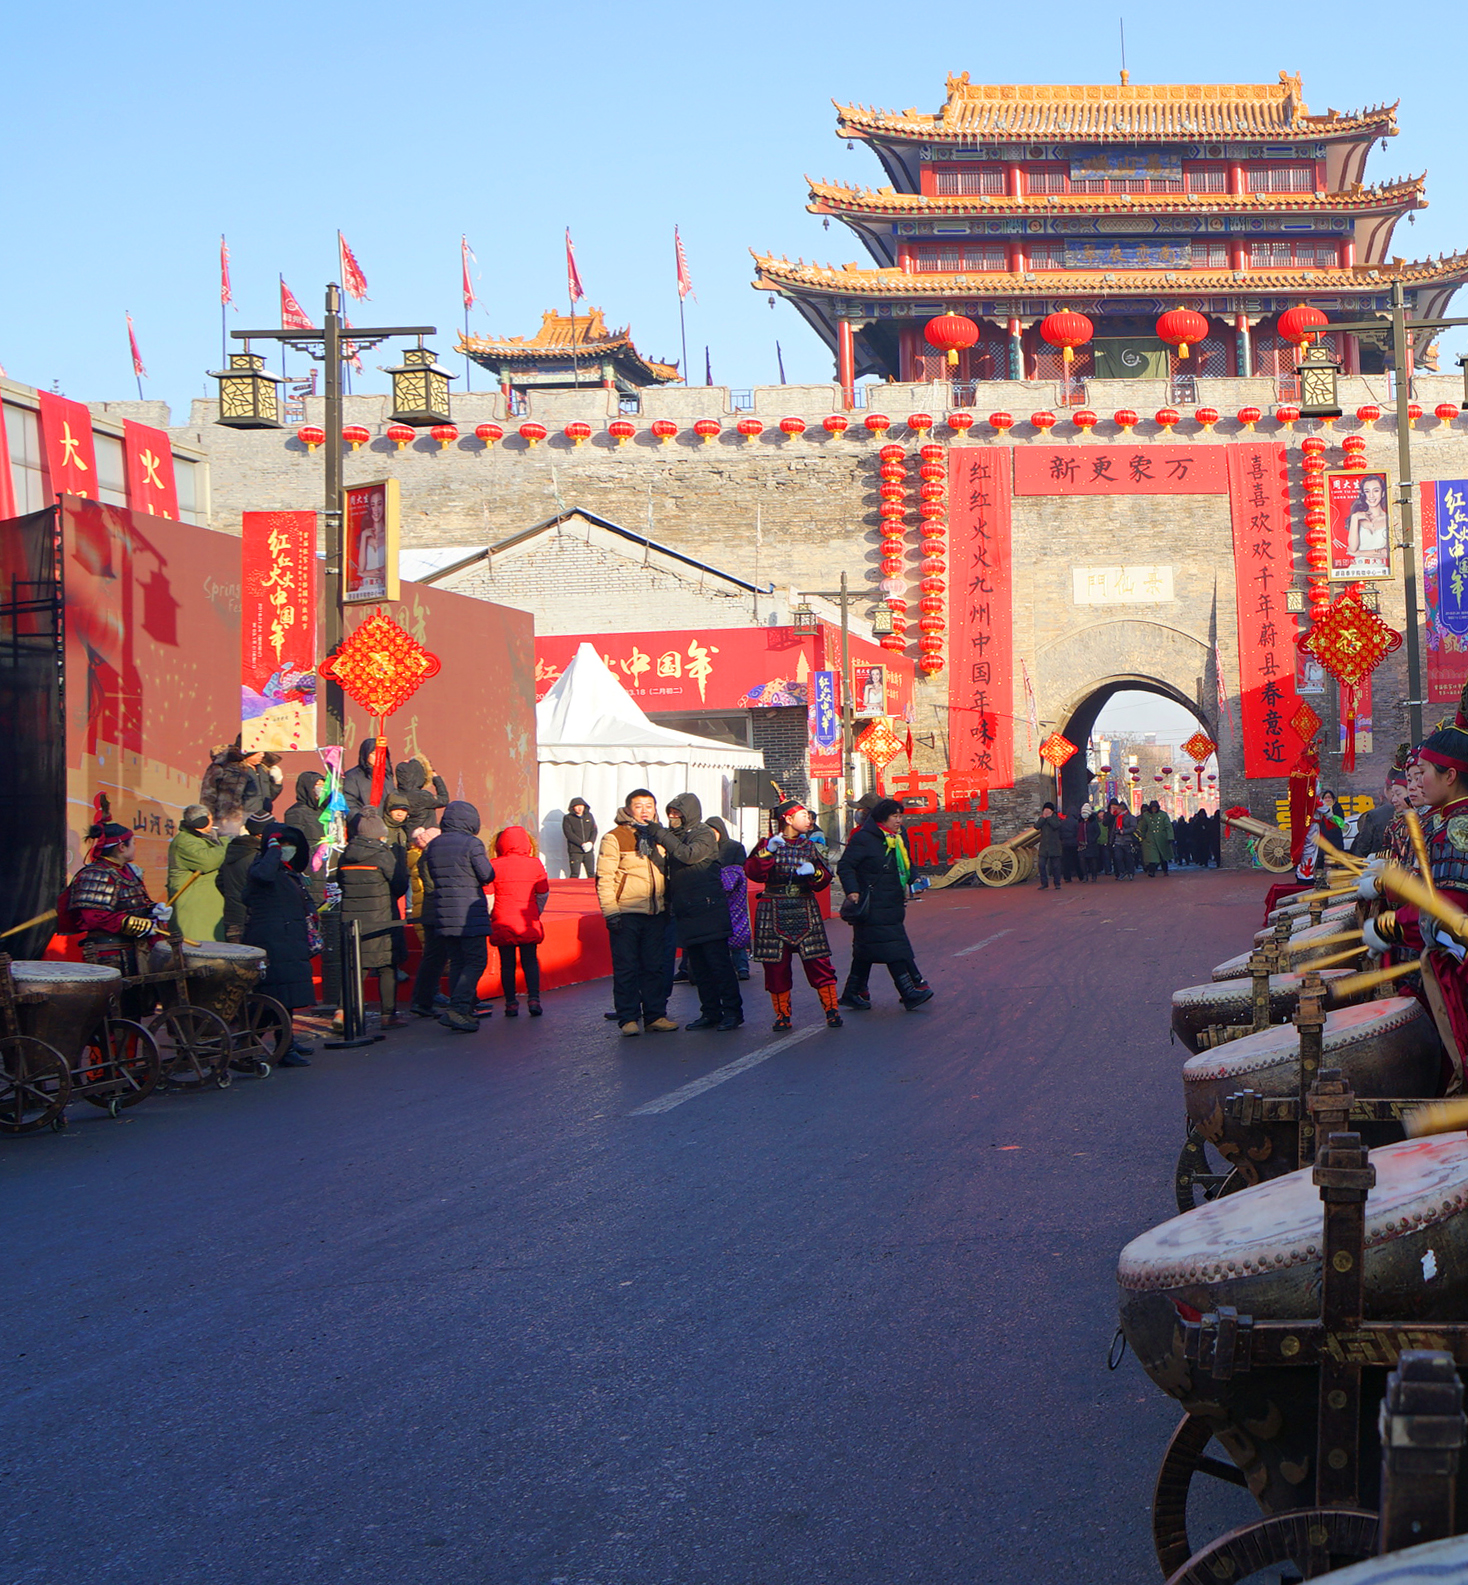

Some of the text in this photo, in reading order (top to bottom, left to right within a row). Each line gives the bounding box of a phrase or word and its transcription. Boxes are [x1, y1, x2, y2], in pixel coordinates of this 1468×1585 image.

[261, 528, 296, 666] 红红火火中国年
[968, 460, 996, 773] 红红火火九州中国年味浓
[1247, 453, 1288, 764] 喜喜欢欢千年蔚县春意近
